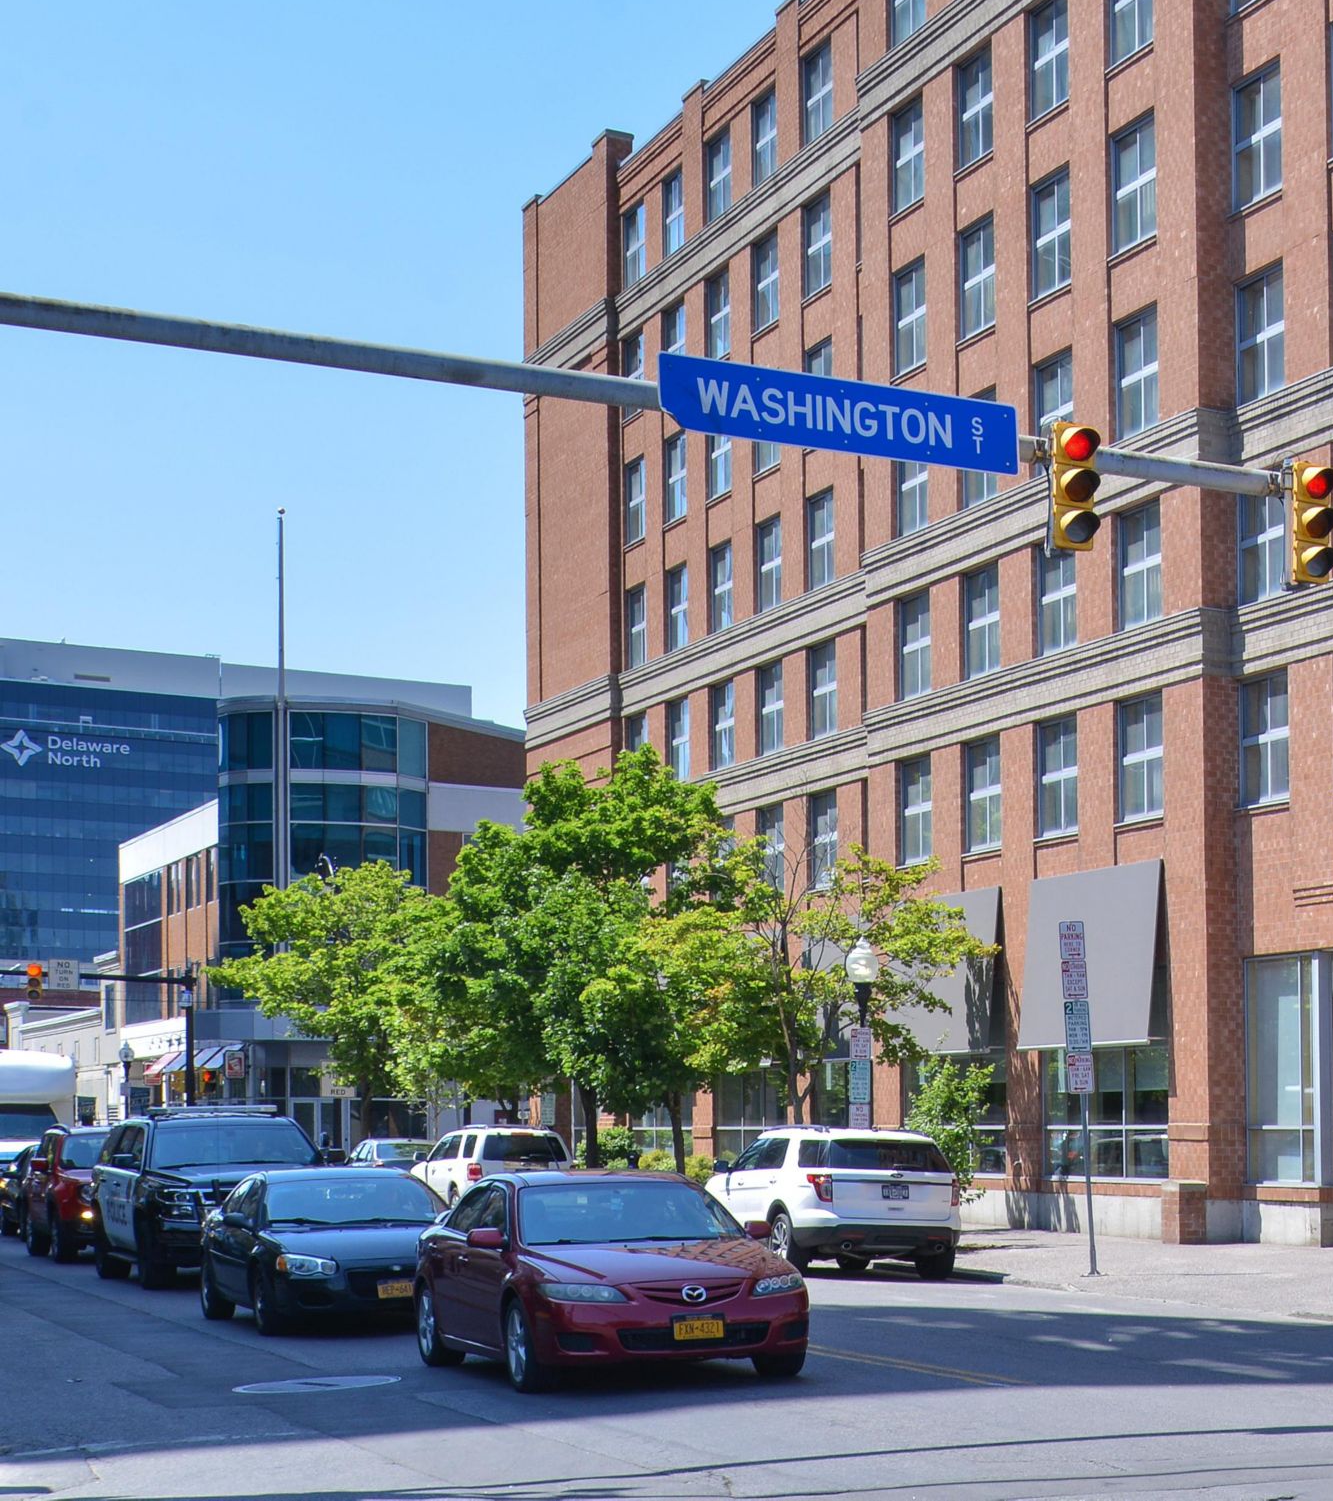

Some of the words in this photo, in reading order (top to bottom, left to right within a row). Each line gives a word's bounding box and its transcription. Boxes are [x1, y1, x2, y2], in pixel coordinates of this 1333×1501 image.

[696, 376, 954, 449] WASHINGTON
[971, 416, 985, 455] ST
[47, 736, 130, 754] Delaware
[47, 752, 101, 768] North
[1066, 924, 1077, 932] NO
[1060, 932, 1083, 940] PARKING
[1065, 1002, 1073, 1013] 2
[330, 1088, 347, 1096] RED
